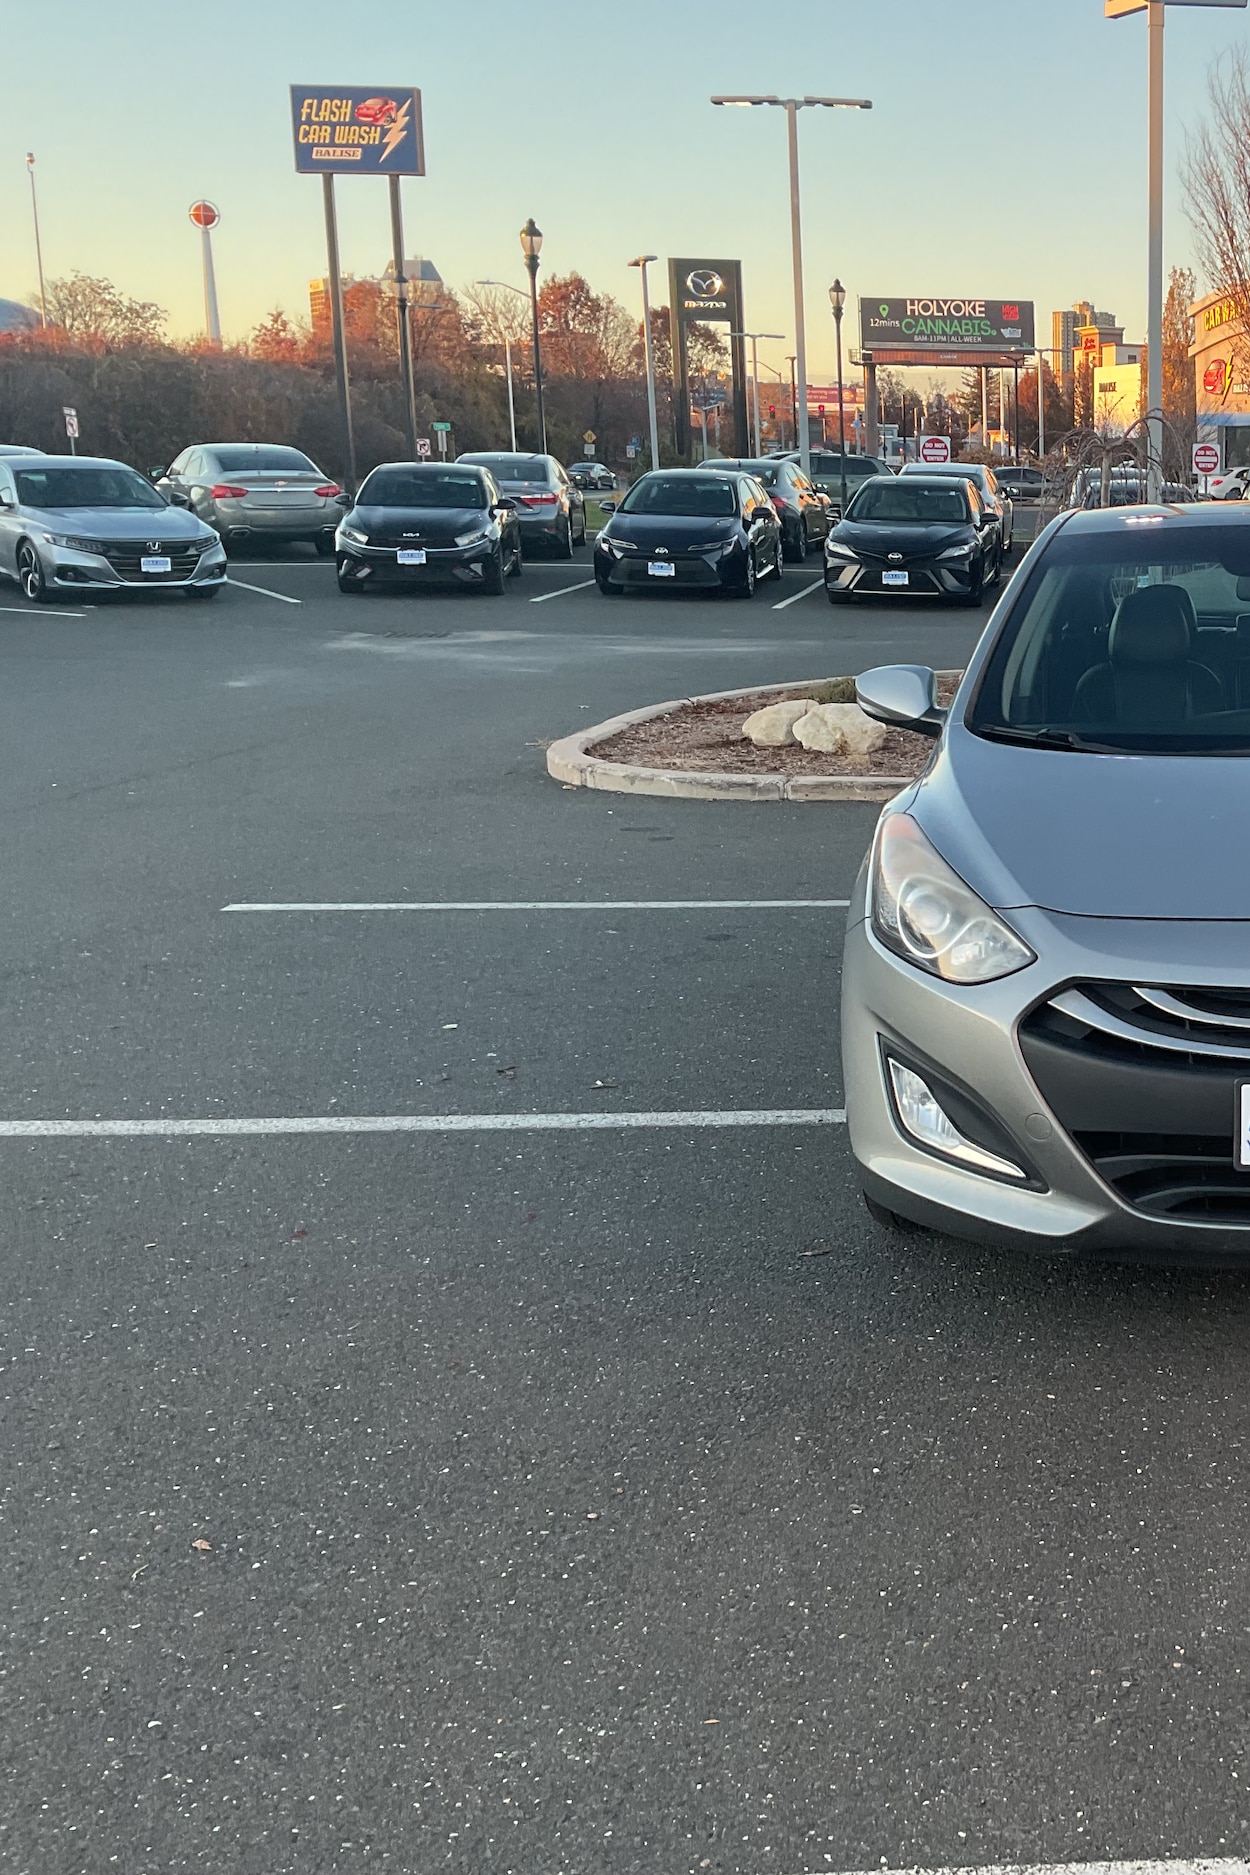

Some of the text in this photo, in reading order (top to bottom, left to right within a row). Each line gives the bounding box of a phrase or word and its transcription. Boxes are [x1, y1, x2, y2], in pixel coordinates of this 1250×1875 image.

[301, 99, 352, 122] FLASH
[299, 125, 381, 144] CAR WASH
[314, 149, 360, 158] BALISE
[906, 299, 986, 317] HOLYOKE
[870, 318, 900, 327] 12mins
[1203, 306, 1220, 331] CAR
